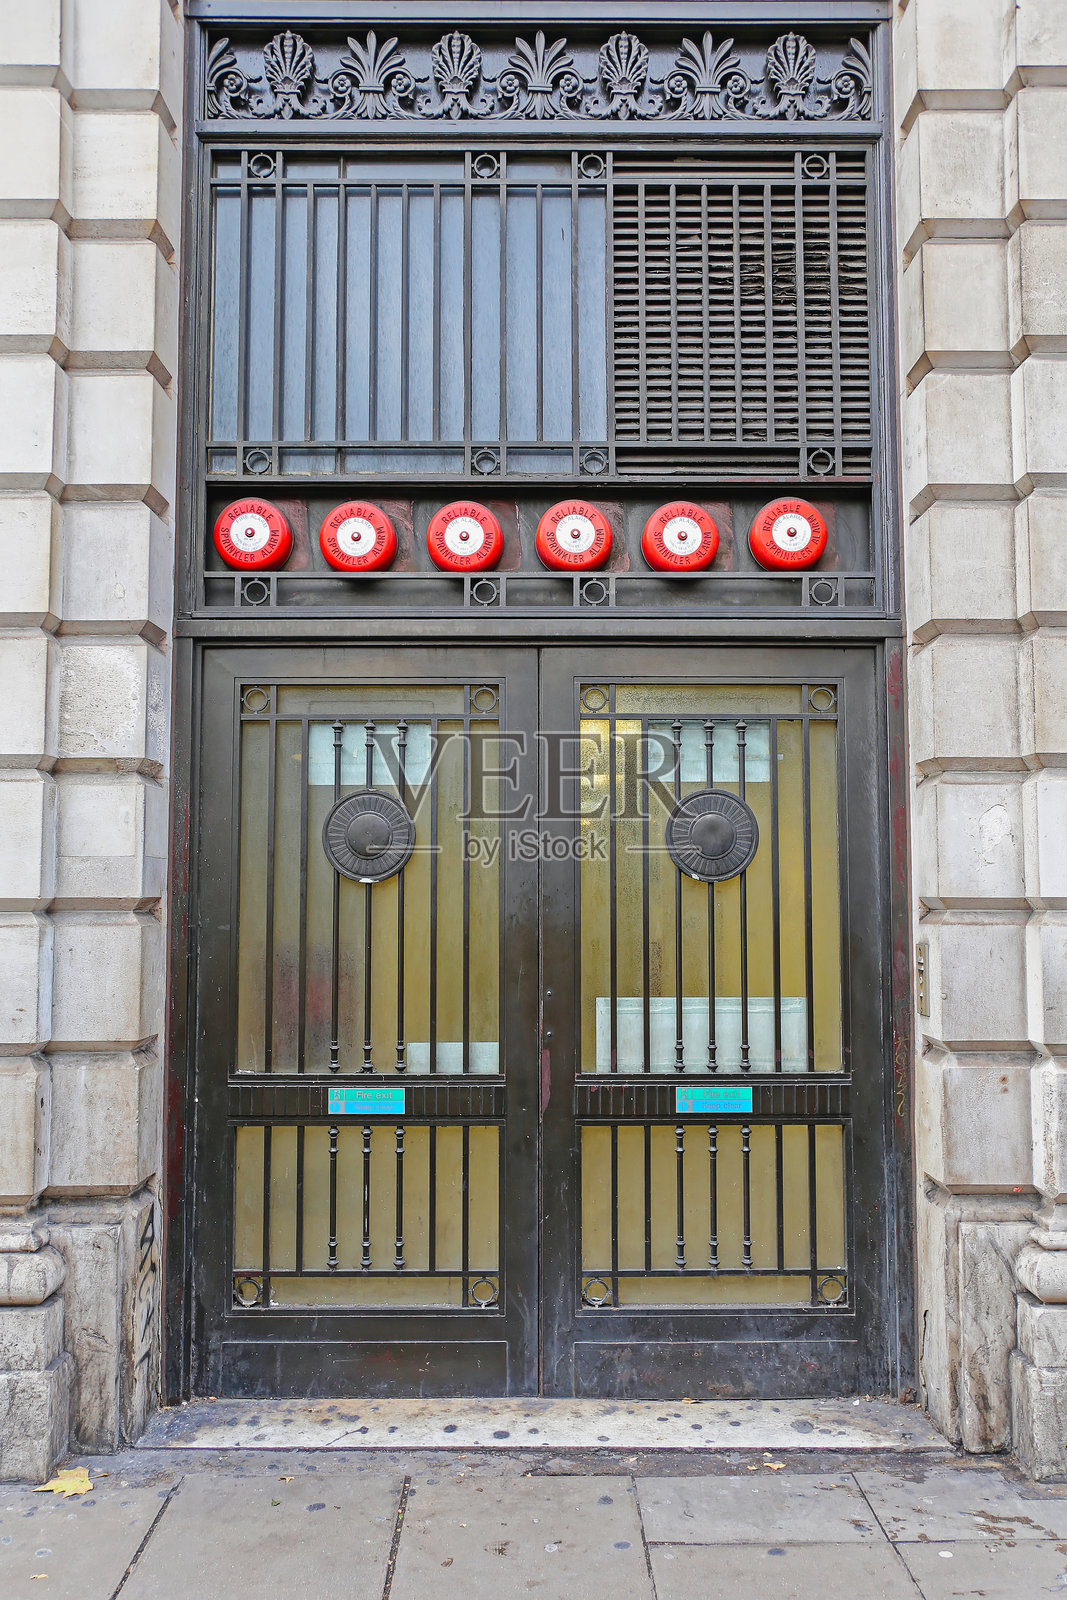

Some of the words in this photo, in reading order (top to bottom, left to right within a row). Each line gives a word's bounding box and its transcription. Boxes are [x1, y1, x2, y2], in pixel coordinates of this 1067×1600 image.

[228, 505, 274, 521] RELIABLE
[250, 514, 267, 528] ALARM
[330, 508, 374, 528] RELIABLE
[442, 508, 487, 524] RELIABLE
[551, 506, 596, 523] RELIABLE
[659, 508, 704, 524] RELIABLE
[763, 504, 800, 531] RELIABLE
[354, 518, 372, 528] ALARM
[461, 518, 480, 528] ALARM
[679, 518, 698, 528] ALARM
[221, 528, 255, 561] SPRINKLER
[262, 530, 279, 558] ALARM
[766, 540, 812, 560] SPRINKLER
[808, 514, 820, 544] ALARM
[328, 538, 368, 565] SPRINKLER
[372, 527, 385, 557] ALARM
[435, 532, 471, 565] SPRINKLER
[476, 533, 493, 560] ALARM
[546, 532, 584, 563] SPRINKLER
[589, 529, 604, 557] ALARM
[654, 532, 690, 564] SPRINKLER
[696, 532, 711, 560] ALARM
[356, 1091, 372, 1099] Fire
[704, 1090, 720, 1098] Fire
